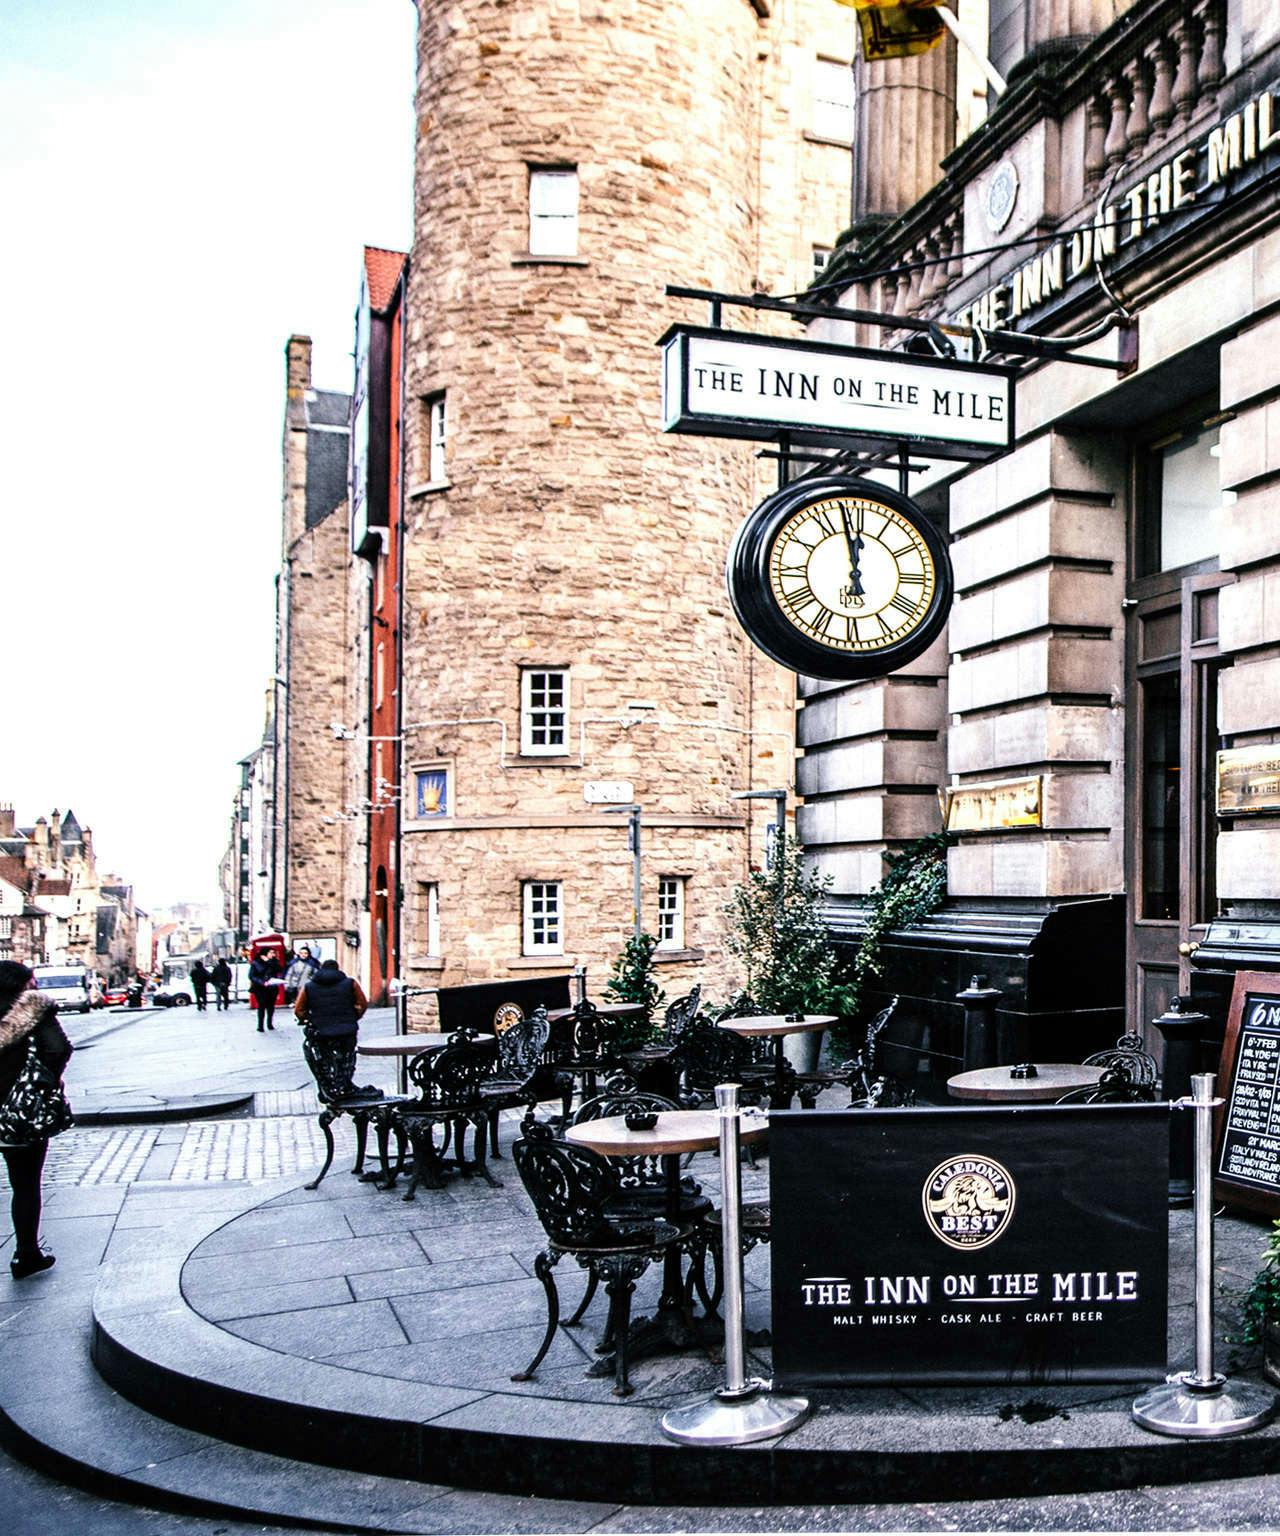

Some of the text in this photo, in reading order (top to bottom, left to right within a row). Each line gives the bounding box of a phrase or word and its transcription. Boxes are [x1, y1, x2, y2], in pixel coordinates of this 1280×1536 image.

[957, 283, 1008, 335] THE
[1013, 242, 1063, 317] INN
[1071, 205, 1117, 276] ON
[1126, 149, 1195, 239] THE
[694, 368, 1004, 422] THE INN ON THE MILE
[1250, 1003, 1266, 1026] 6
[932, 1161, 1006, 1192] CALEDONIA
[941, 1215, 998, 1231] BEST
[802, 1271, 1139, 1305] THE INN ON THE MILE
[833, 1311, 1104, 1326] MALT WHISKY CASK ALE CRAFT BEER
